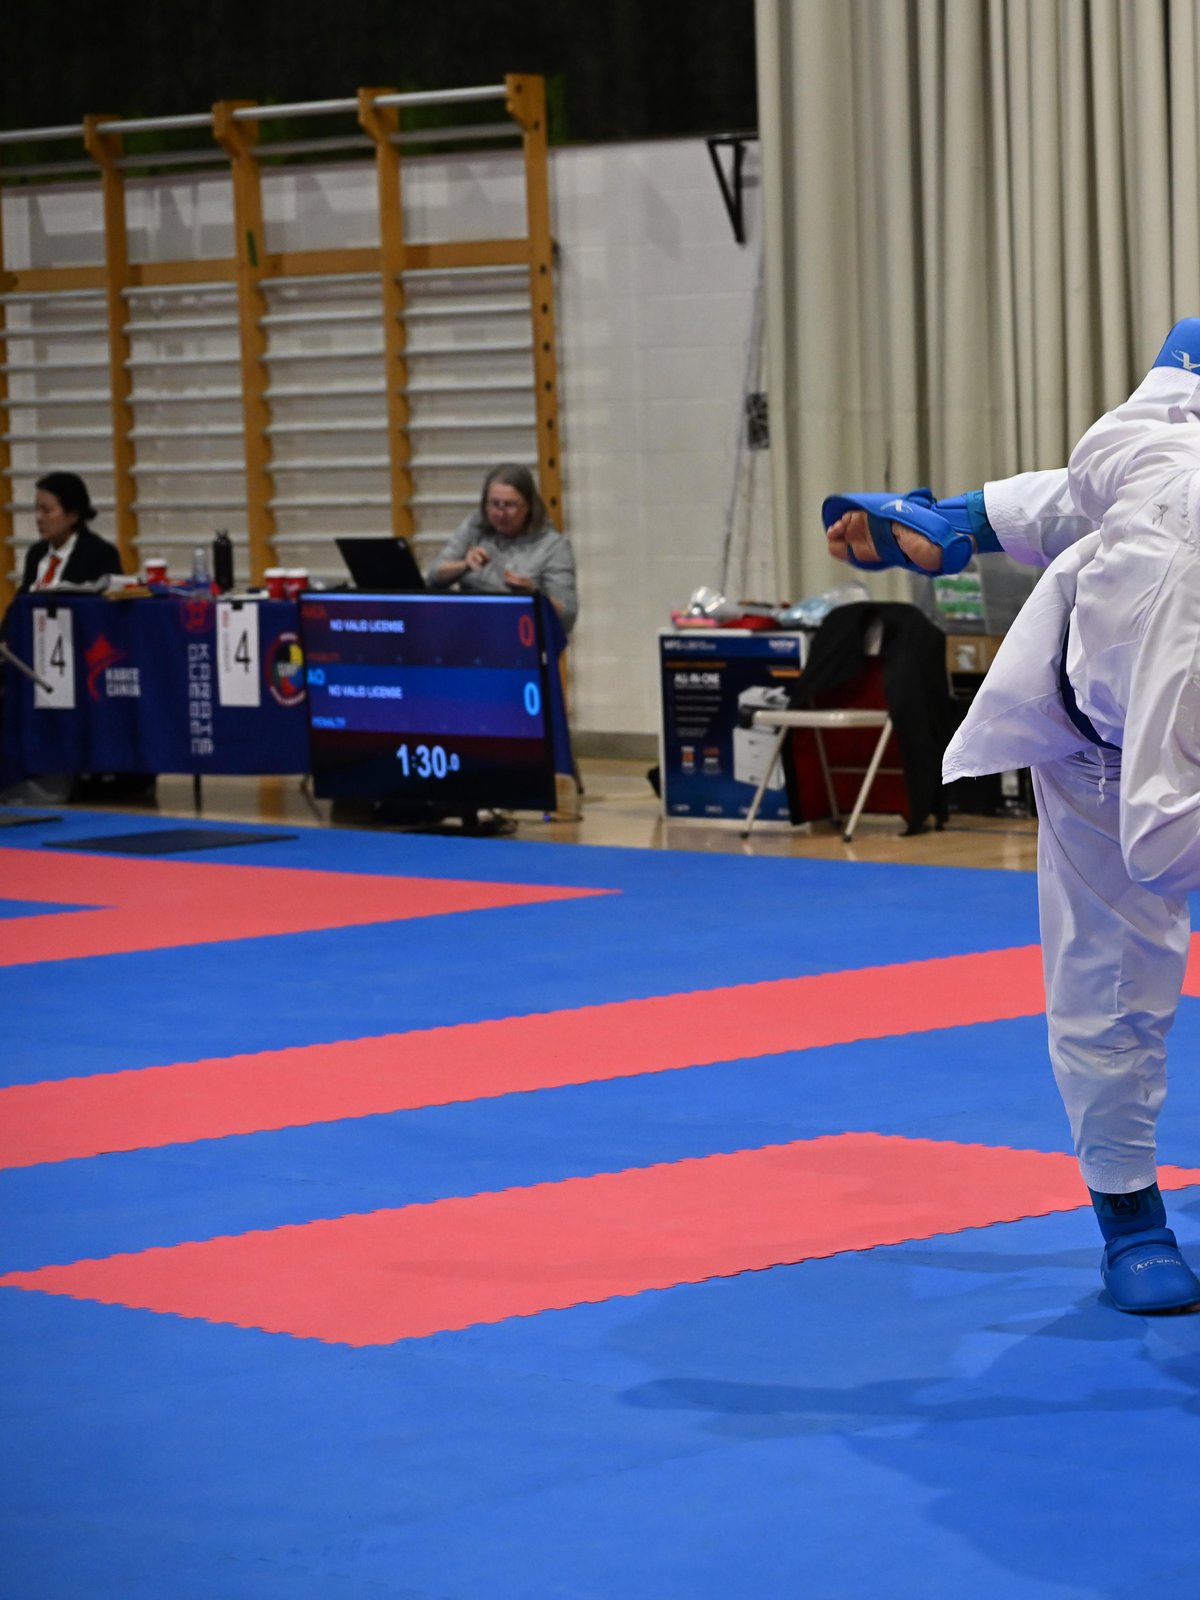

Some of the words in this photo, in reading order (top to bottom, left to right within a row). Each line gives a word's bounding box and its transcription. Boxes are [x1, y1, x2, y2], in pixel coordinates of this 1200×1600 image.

[370, 620, 405, 633] LICENSE
[519, 614, 535, 647] 0
[51, 634, 66, 677] 4
[234, 630, 251, 674] 4
[524, 682, 541, 716] 0
